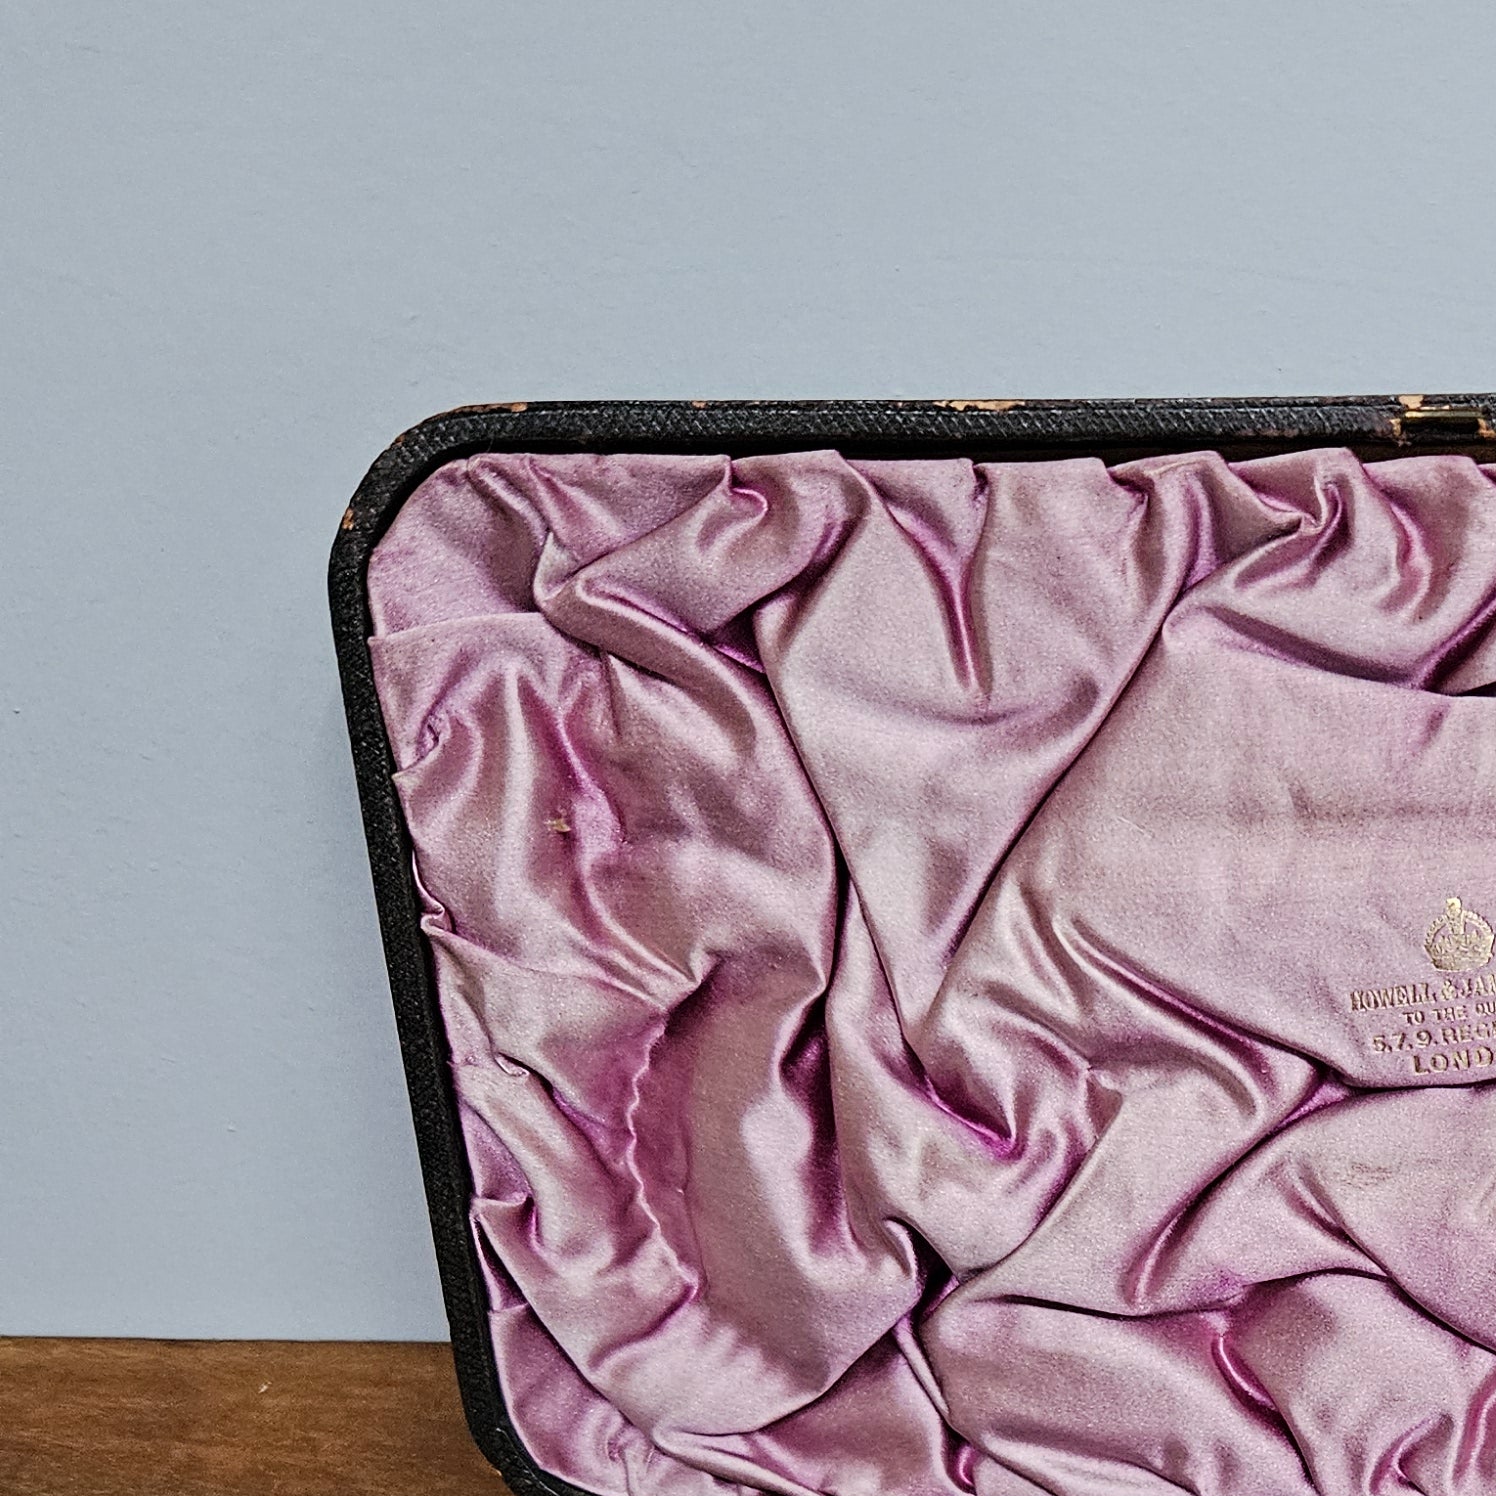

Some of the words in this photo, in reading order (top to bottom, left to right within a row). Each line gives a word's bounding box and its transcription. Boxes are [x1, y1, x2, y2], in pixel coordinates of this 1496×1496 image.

[1350, 983, 1437, 1012] HOWELL
[1402, 1010, 1425, 1026] TO
[1432, 1005, 1468, 1023] THE
